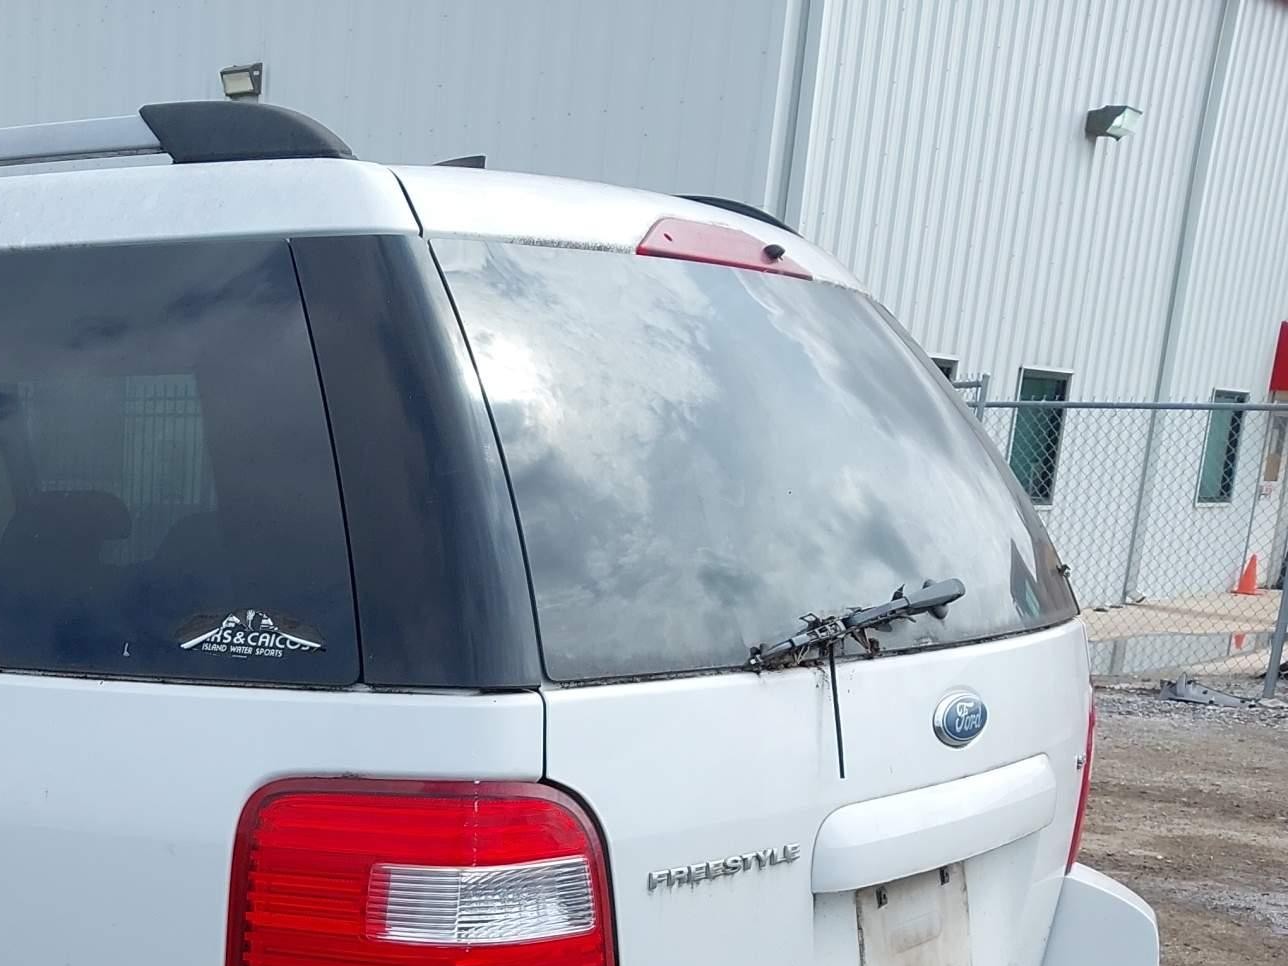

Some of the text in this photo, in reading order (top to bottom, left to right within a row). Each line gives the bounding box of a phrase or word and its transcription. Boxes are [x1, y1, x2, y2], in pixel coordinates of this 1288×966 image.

[202, 642, 282, 657] ISLAND WATER SPORTS
[955, 701, 982, 732] Ford
[648, 844, 801, 891] FREESTYLE
